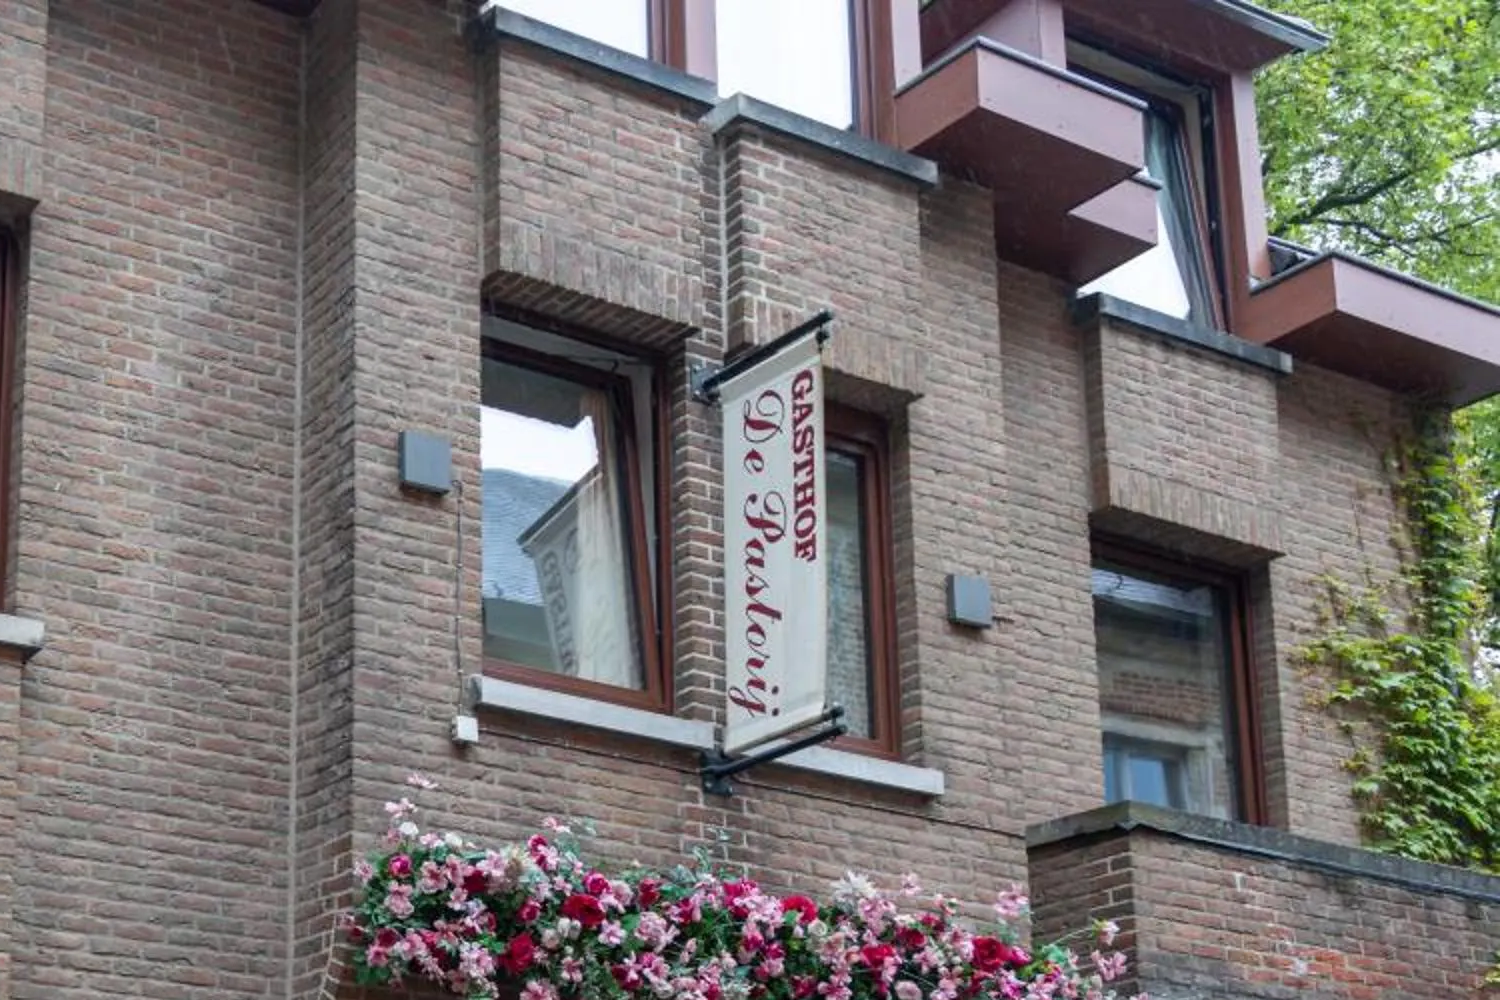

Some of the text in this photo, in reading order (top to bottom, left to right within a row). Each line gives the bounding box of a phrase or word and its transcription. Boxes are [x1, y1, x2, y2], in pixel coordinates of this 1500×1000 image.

[728, 389, 787, 718] De Pastorij
[791, 368, 818, 563] GASTHOF
